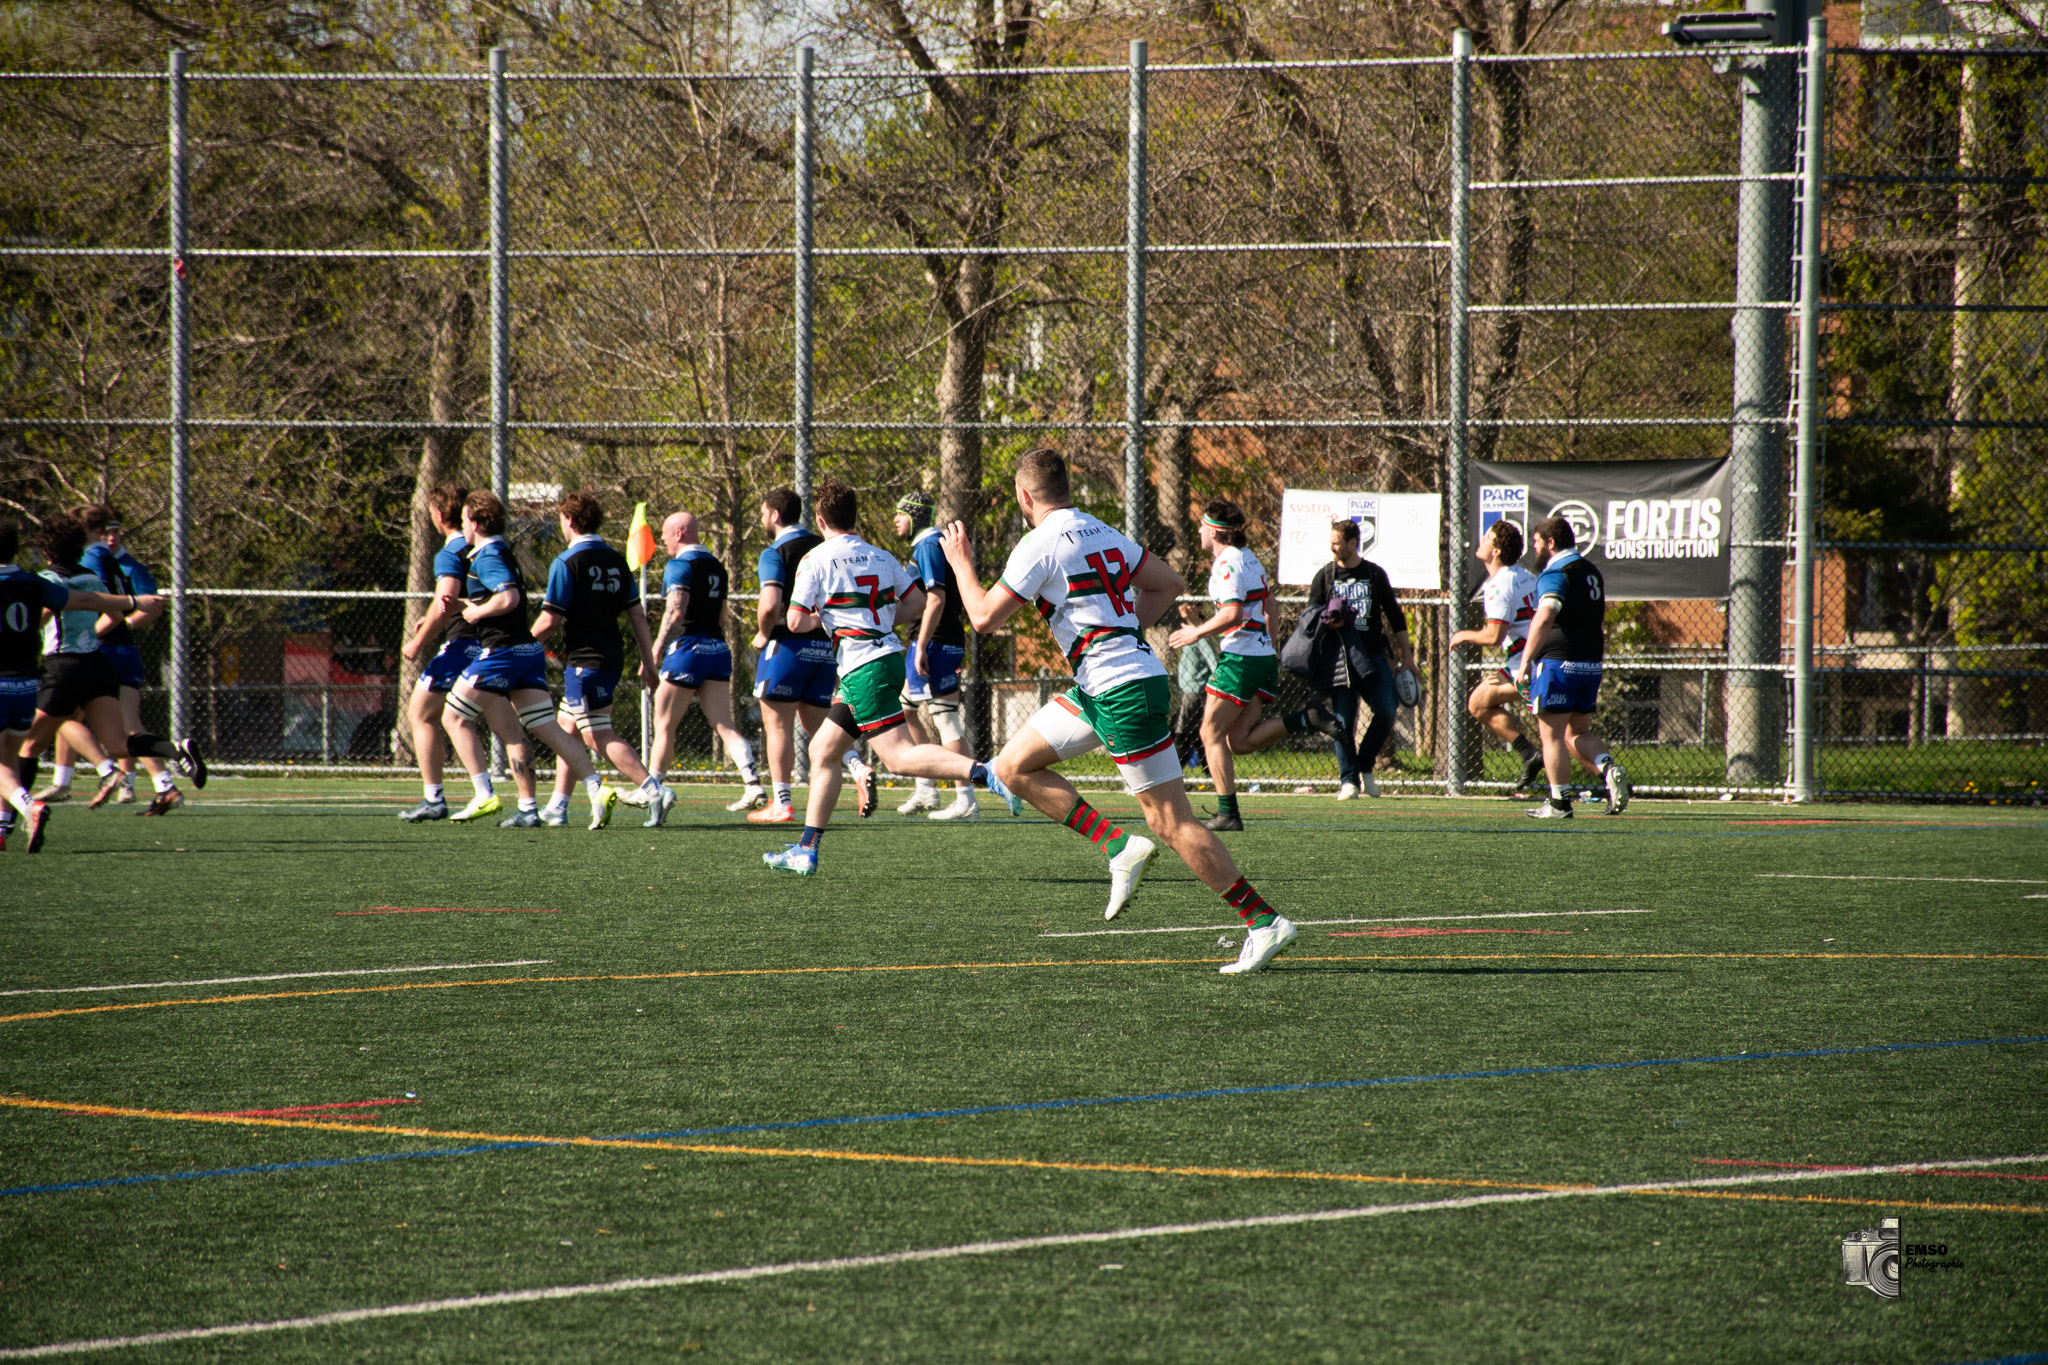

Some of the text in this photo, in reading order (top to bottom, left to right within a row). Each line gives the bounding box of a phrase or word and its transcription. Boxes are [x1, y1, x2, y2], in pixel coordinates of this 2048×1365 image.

[1351, 501, 1376, 509] PARC
[1483, 489, 1525, 501] PARC
[1606, 497, 1722, 541] FORTIS
[1077, 526, 1102, 539] TEAM
[843, 555, 869, 565] TEAM
[1605, 539, 1720, 559] CONSTRUCTION
[588, 565, 621, 594] 25
[708, 575, 720, 599] 2
[1085, 547, 1135, 618] 12
[1586, 575, 1601, 601] 3
[854, 574, 881, 626] 7
[3, 602, 28, 632] 0
[1401, 671, 1413, 701] ILBERT
